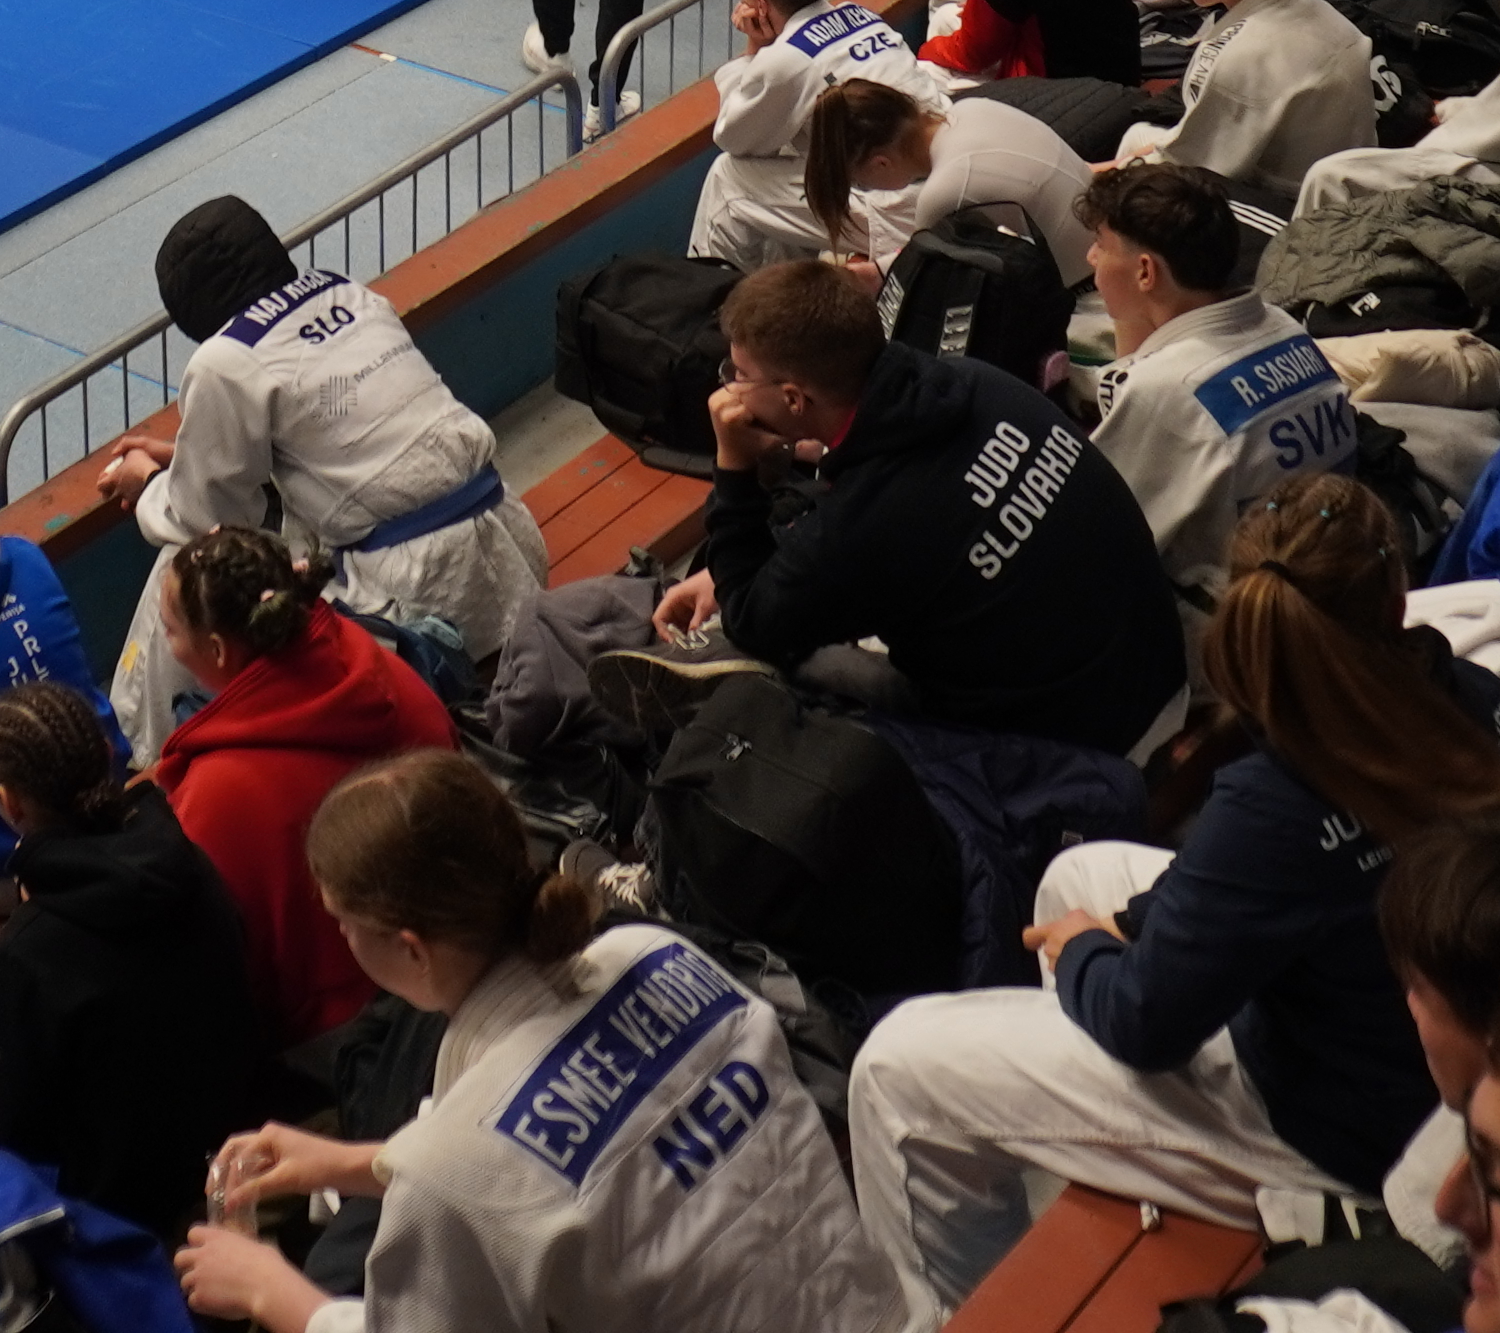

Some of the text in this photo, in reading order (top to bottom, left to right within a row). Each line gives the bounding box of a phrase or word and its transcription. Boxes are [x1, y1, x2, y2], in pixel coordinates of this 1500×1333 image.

[803, 11, 850, 47] ADAM
[849, 32, 898, 62] CZE
[244, 292, 288, 326] NAJ
[299, 306, 355, 345] SLO
[964, 420, 1031, 509] JUDO
[1268, 389, 1353, 470] SVK
[968, 424, 1083, 581] SLOVAKIA
[512, 1031, 637, 1171] ESMEE
[653, 1060, 769, 1193] NED
